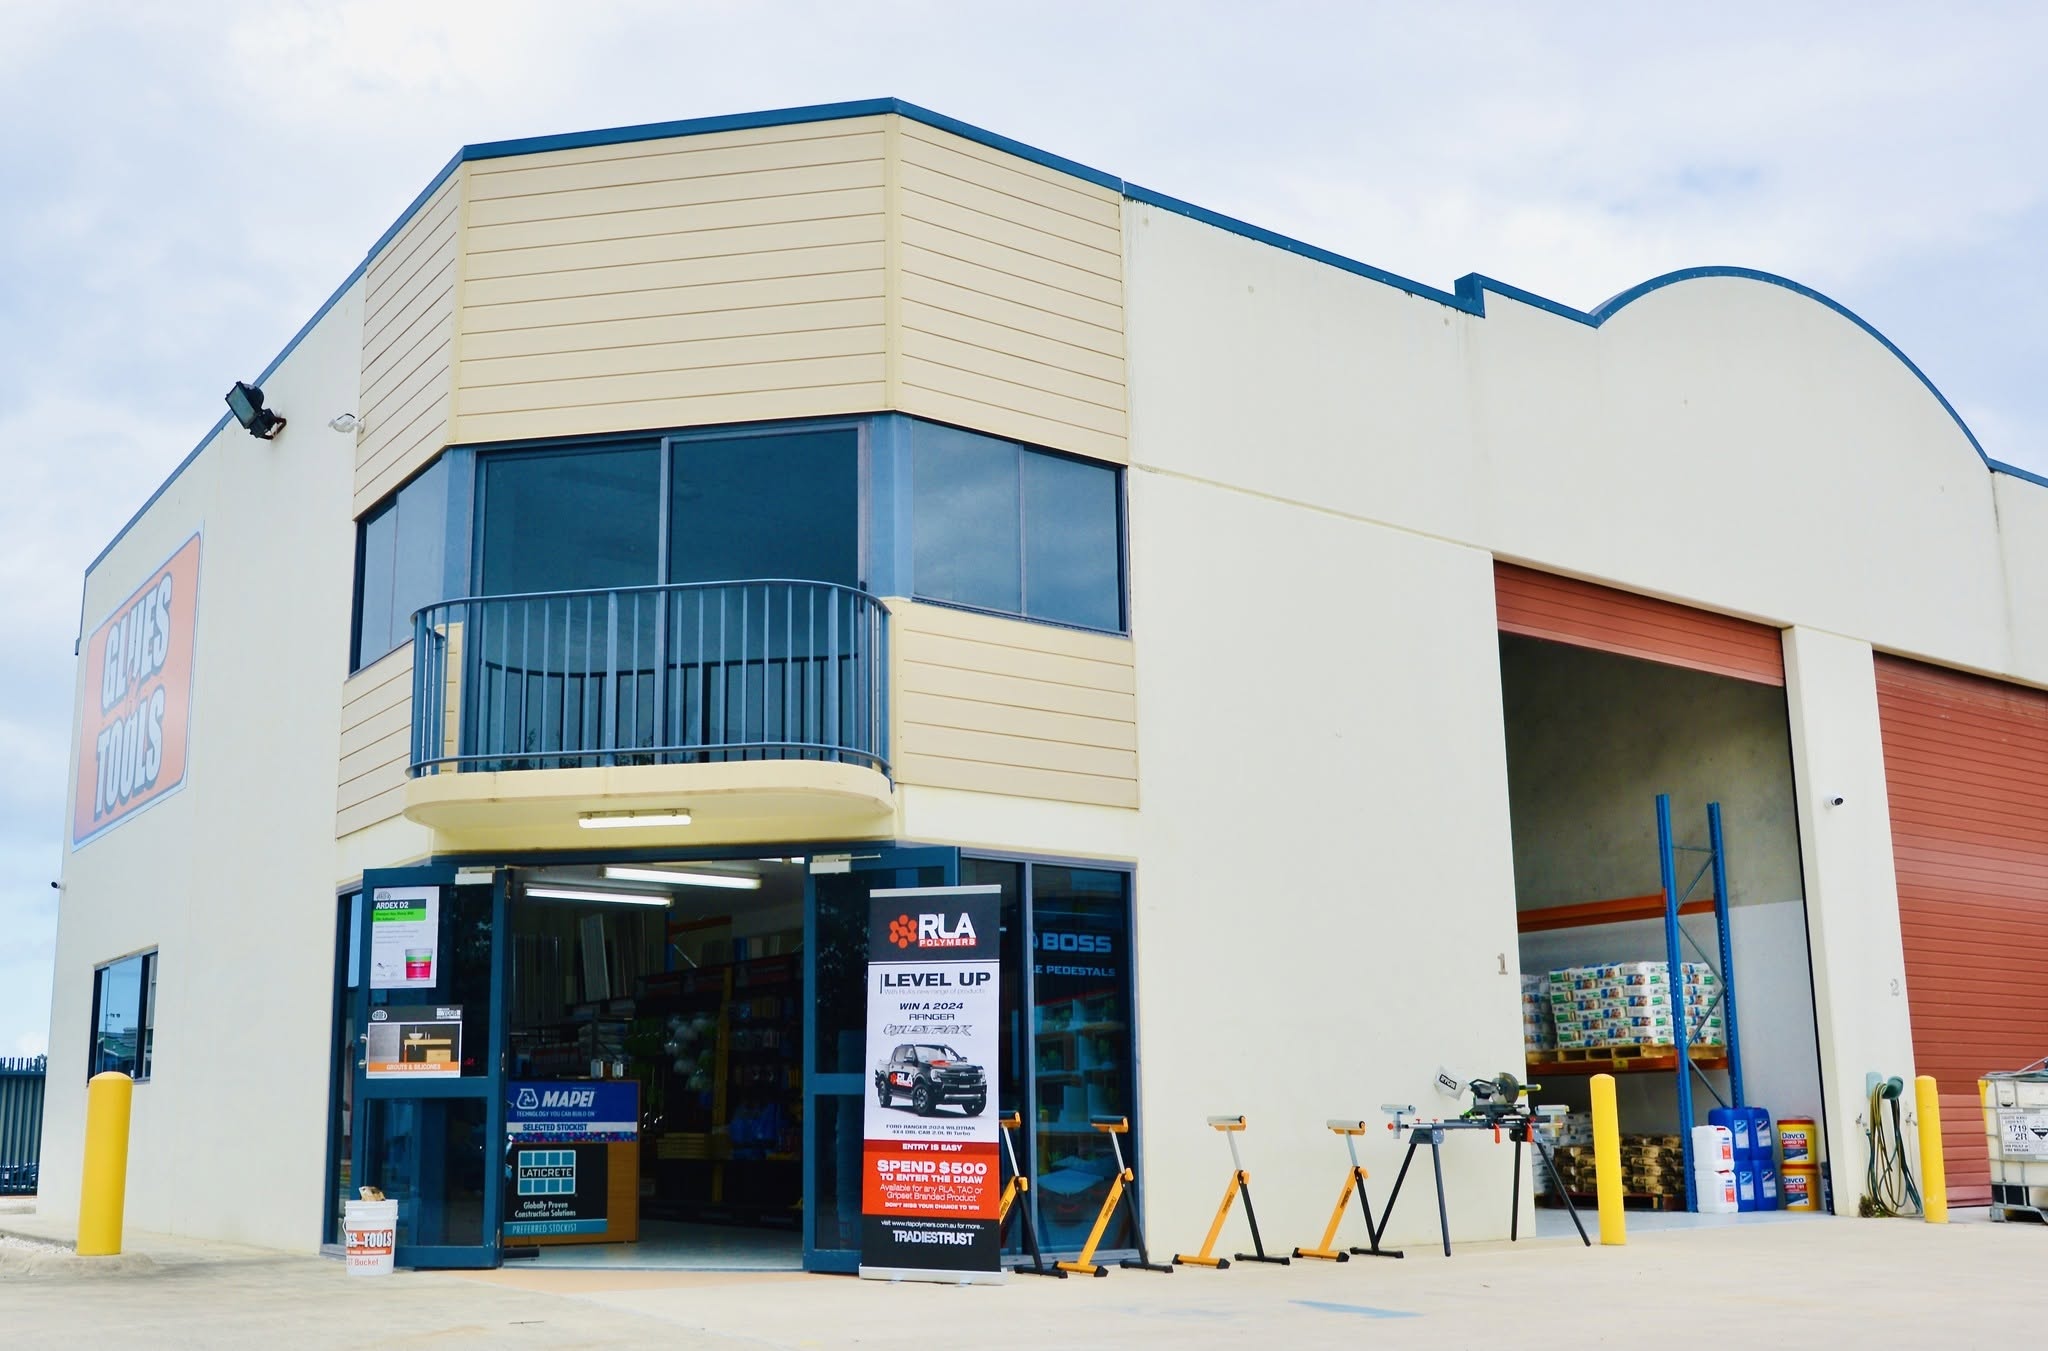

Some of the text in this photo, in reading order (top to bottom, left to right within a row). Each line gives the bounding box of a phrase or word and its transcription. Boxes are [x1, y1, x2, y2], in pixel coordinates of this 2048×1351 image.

[103, 572, 172, 714] GLUES
[95, 685, 165, 820] TOOLS
[376, 901, 409, 910] ARDEX D2
[918, 913, 976, 939] RLA
[919, 938, 976, 947] POLYMERS
[1042, 932, 1112, 952] BOSS
[1046, 965, 1116, 976] PEDESTALS
[1497, 953, 1508, 975] 1
[884, 972, 991, 987] LEVEL UP
[1890, 978, 1900, 996] 2
[900, 1002, 920, 1010] WIN
[542, 1090, 594, 1108] MAPEI
[521, 1168, 572, 1178] LATICRETE
[877, 1160, 987, 1175] SPEND $500
[896, 1174, 928, 1182] ENTER
[953, 1176, 983, 1184] DRAW
[886, 1192, 912, 1200] Gripset
[947, 1194, 976, 1202] Product
[523, 1201, 547, 1210] Globally
[512, 1223, 576, 1234] PREFERRED STOCKIST
[892, 1220, 956, 1228] www.rlapolymers.com.au
[364, 1231, 392, 1248] TOOLS
[893, 1230, 974, 1245] TRADIESTRUST
